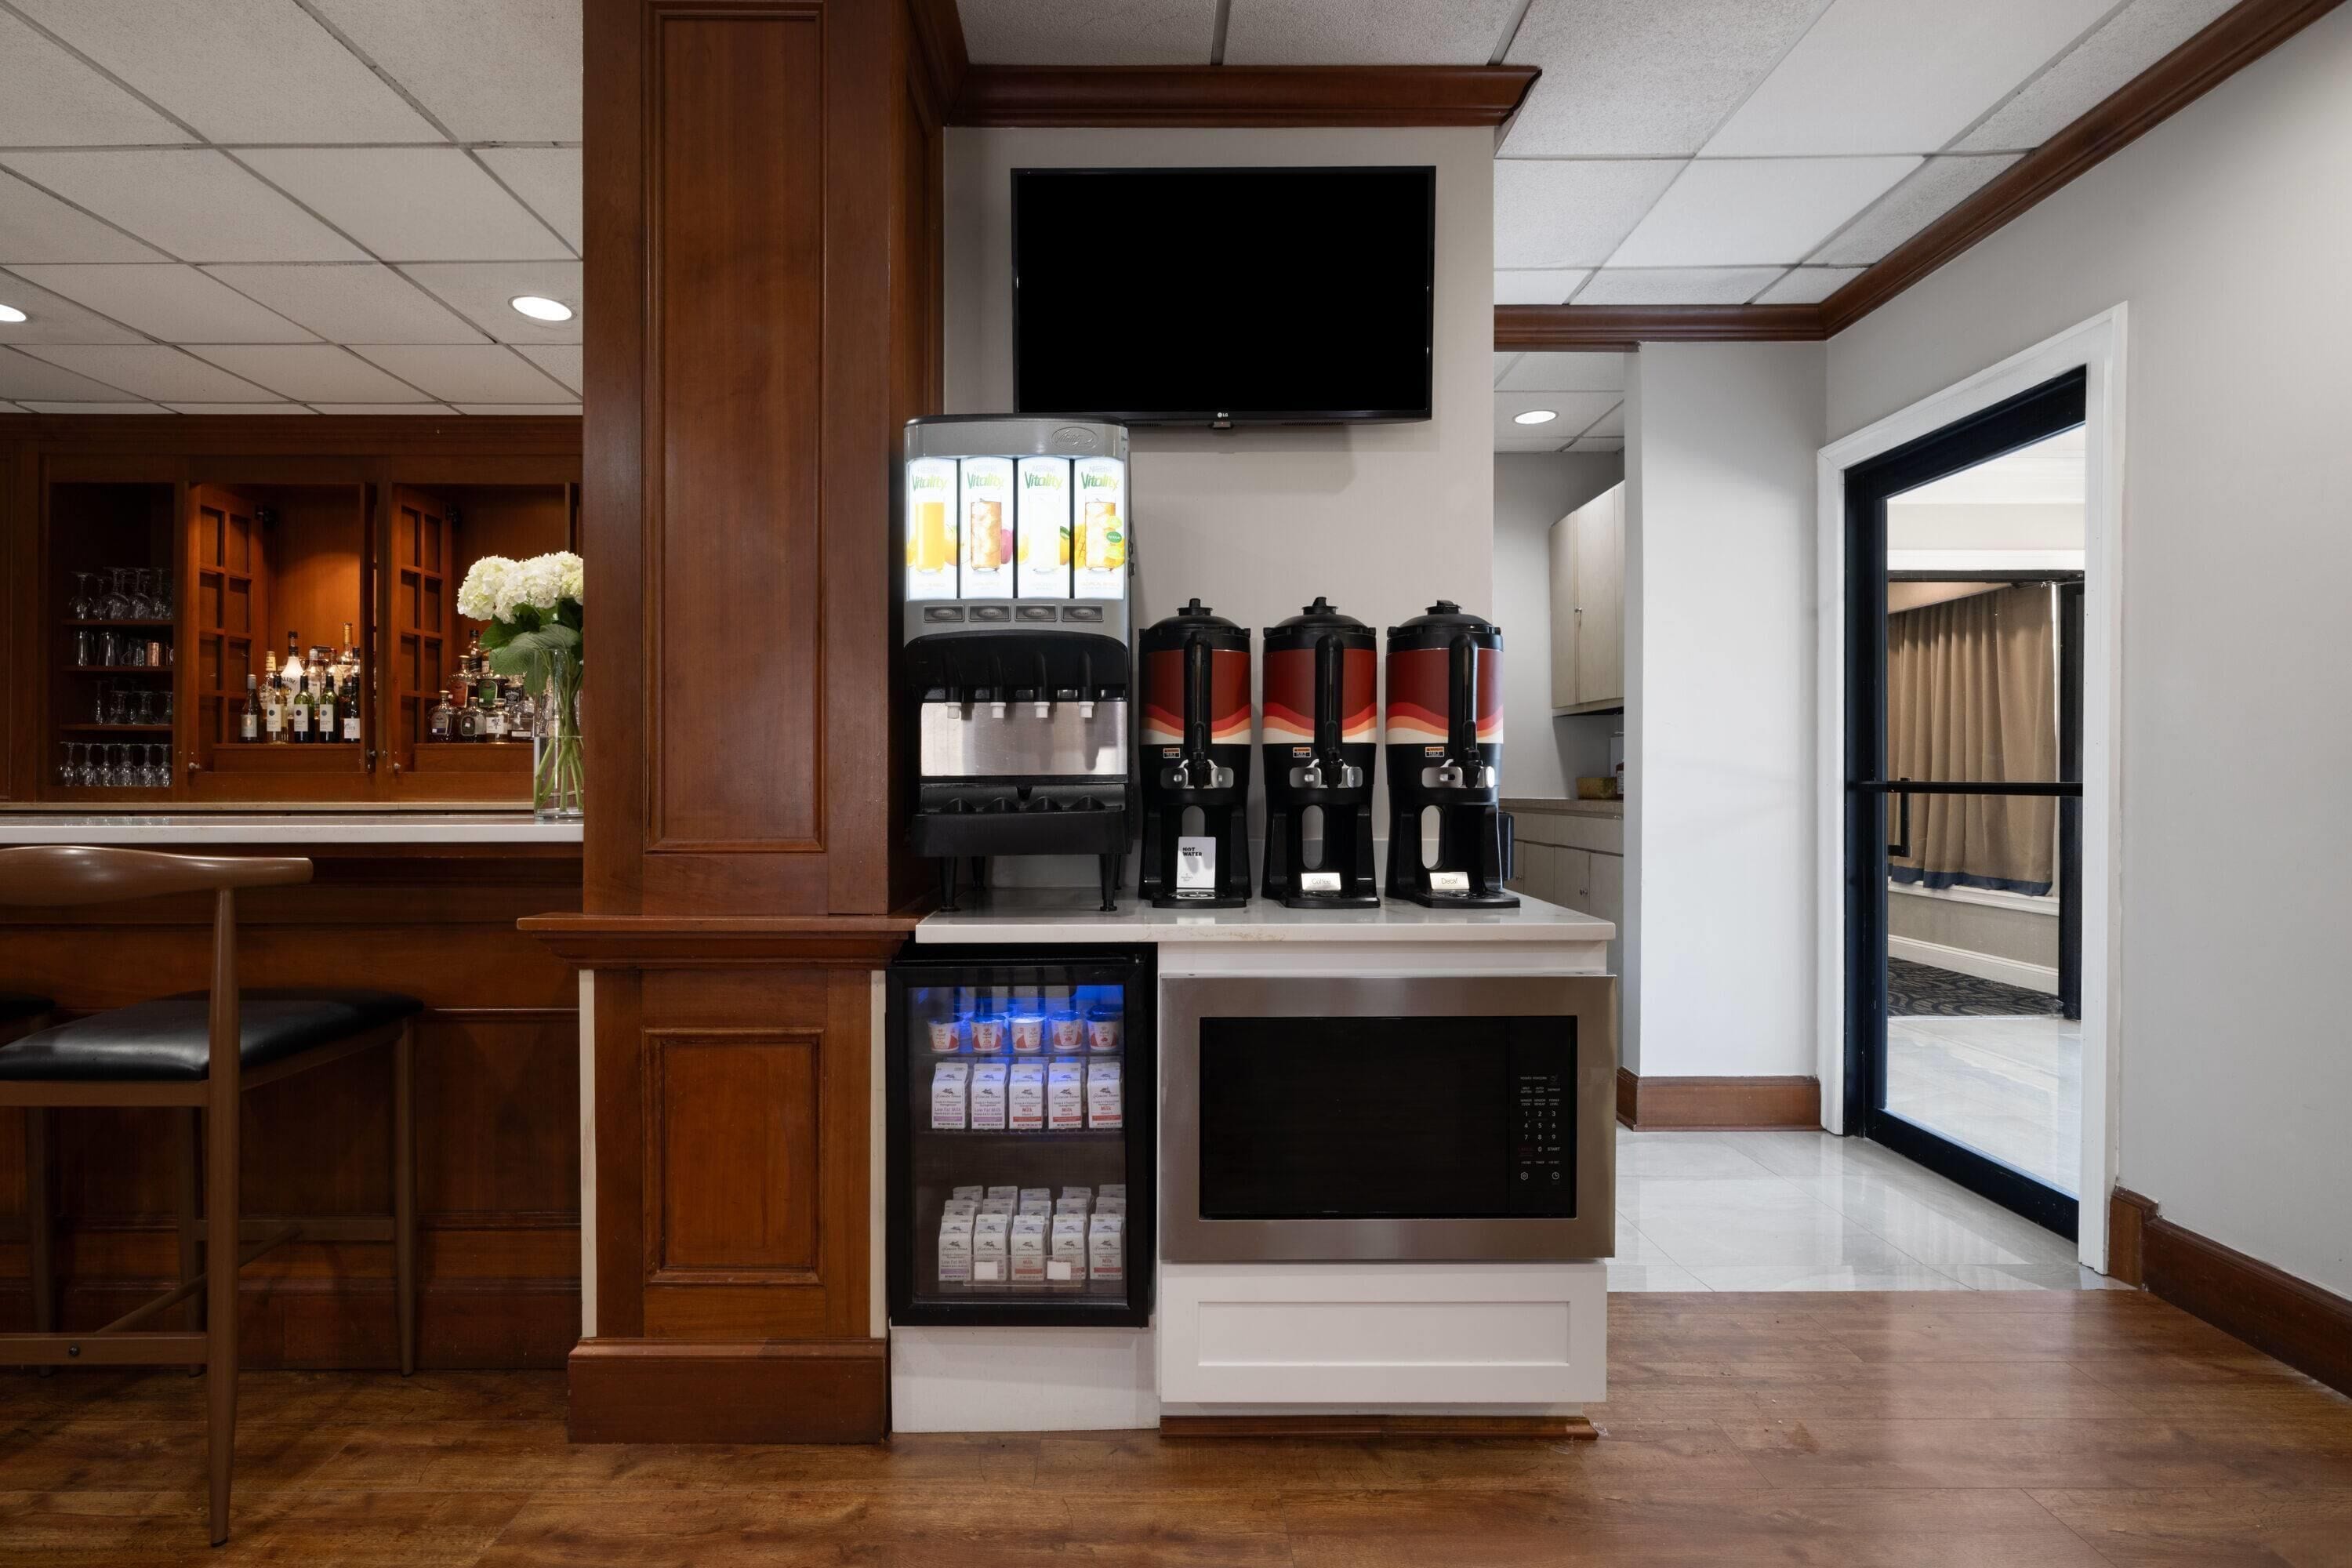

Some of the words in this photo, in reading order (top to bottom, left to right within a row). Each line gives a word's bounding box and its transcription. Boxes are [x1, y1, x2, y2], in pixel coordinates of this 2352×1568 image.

[912, 474, 948, 491] Vitality
[967, 472, 1004, 489] Vitality
[1025, 471, 1063, 490] Vitality
[1081, 471, 1120, 490] Vitality
